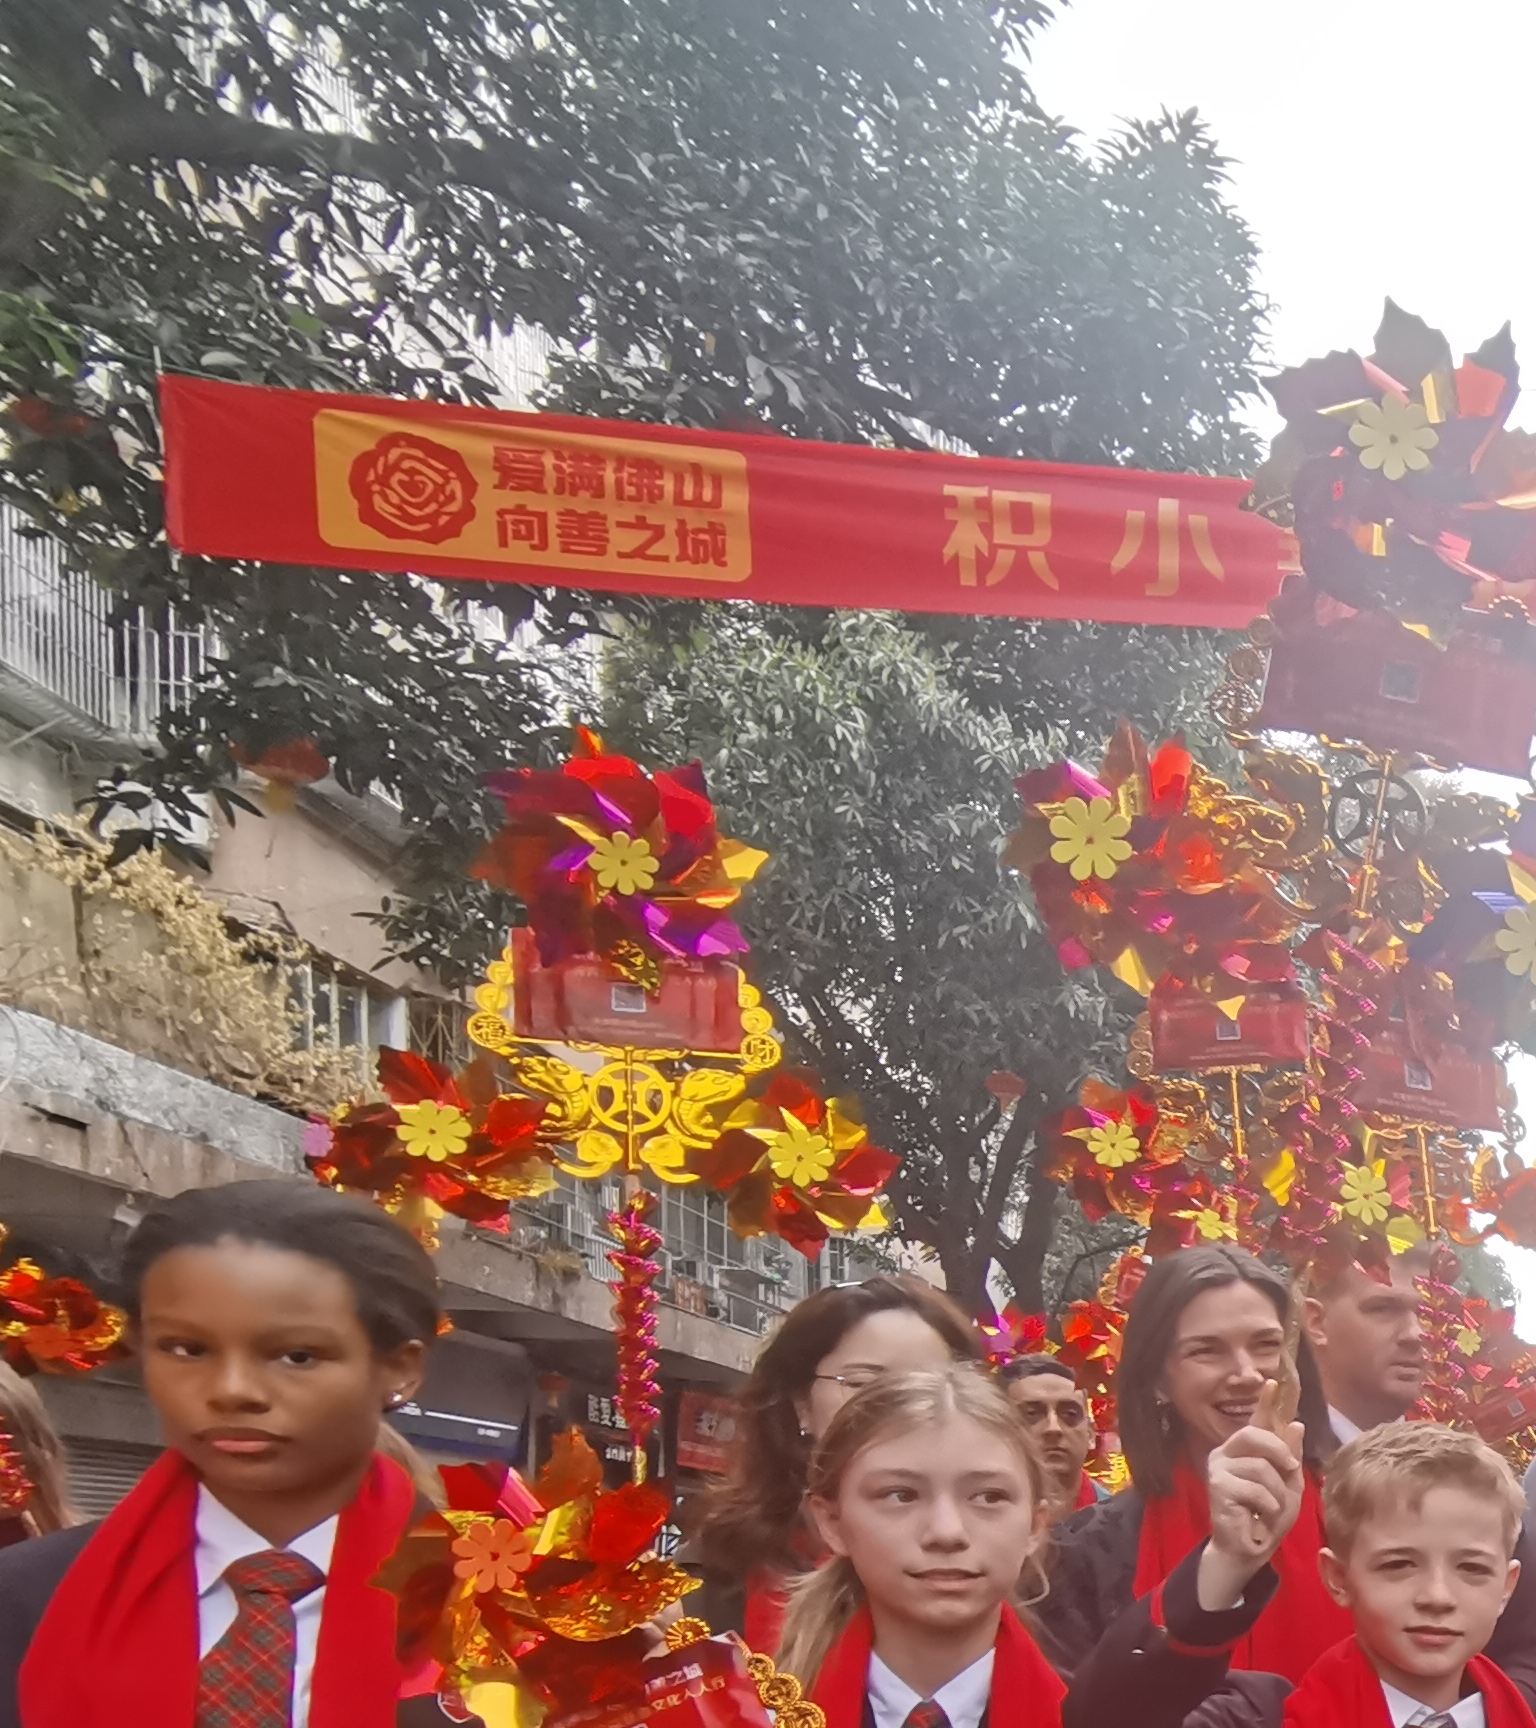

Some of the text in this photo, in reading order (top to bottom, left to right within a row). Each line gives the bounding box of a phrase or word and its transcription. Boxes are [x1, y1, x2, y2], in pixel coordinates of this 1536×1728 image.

[492, 445, 723, 512] 爱满佛山
[496, 504, 728, 568] 向善之城
[942, 482, 1303, 598] 积小
